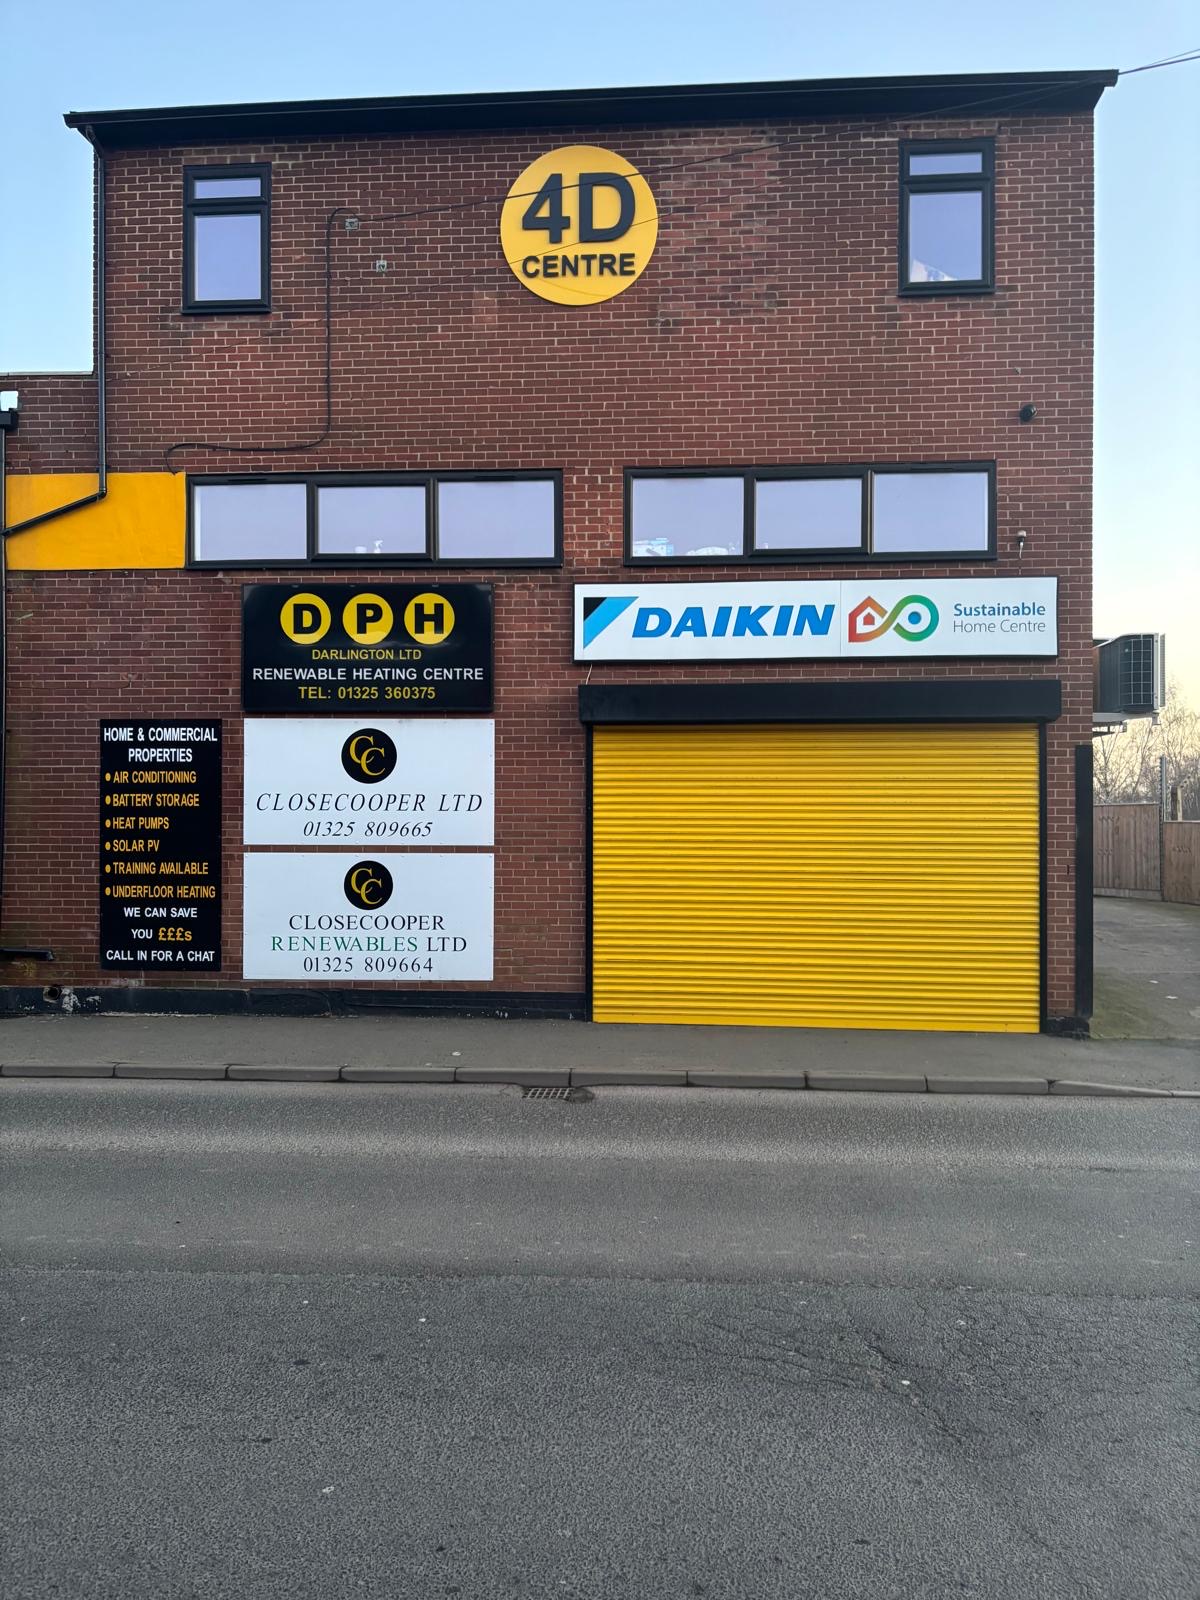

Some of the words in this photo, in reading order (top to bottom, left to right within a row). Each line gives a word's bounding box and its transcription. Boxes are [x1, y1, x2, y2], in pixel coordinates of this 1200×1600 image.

[522, 172, 635, 243] 4D
[521, 253, 636, 278] CENTRE
[953, 602, 1046, 617] Sustainable
[632, 604, 835, 638] DAIKIN
[953, 620, 997, 633] Home
[1000, 619, 1046, 633] Centre
[312, 650, 393, 660] DARLINGTON
[399, 650, 421, 660] LTD
[253, 668, 346, 680] RENEWABLE
[353, 668, 417, 680] HEATING
[423, 668, 483, 680] CENTRE
[298, 687, 331, 699] TEL:
[338, 687, 378, 699] 01325
[384, 687, 436, 699] 360375
[103, 727, 134, 742] HOME
[137, 727, 145, 742] &
[148, 727, 218, 742] COMMERCIAL
[128, 748, 193, 762] PROPERTIES
[113, 771, 129, 783] AIR
[131, 771, 197, 783] CONDITIONING
[112, 794, 153, 807] BATTERY
[155, 794, 200, 807] STORAGE
[256, 793, 426, 811] CLOSECOOPER
[438, 794, 483, 812] LTD
[112, 817, 136, 829] HEAT
[138, 817, 170, 829] PUMPS
[303, 821, 355, 837] 01325
[364, 821, 433, 837] 809665
[112, 840, 145, 852] SOLAR
[147, 840, 160, 852] PV
[112, 862, 157, 875] TRAINING
[159, 862, 209, 875] AVAILABLE
[112, 885, 174, 898] UNDERFLOOR
[176, 885, 216, 898] HEATING
[123, 907, 141, 917] WE
[144, 907, 167, 917] CAN
[170, 907, 198, 917] SAVE
[289, 914, 445, 931] CLOSECOOPER
[131, 929, 153, 939] YOU
[271, 936, 418, 952] RENEWABLES
[427, 937, 467, 952] LTD
[106, 950, 134, 961] CALL
[137, 950, 147, 961] IN
[151, 950, 173, 961] FOR
[175, 950, 185, 962] A
[187, 950, 216, 962] CHAT
[303, 957, 353, 973] 01325
[364, 957, 434, 973] 809664
